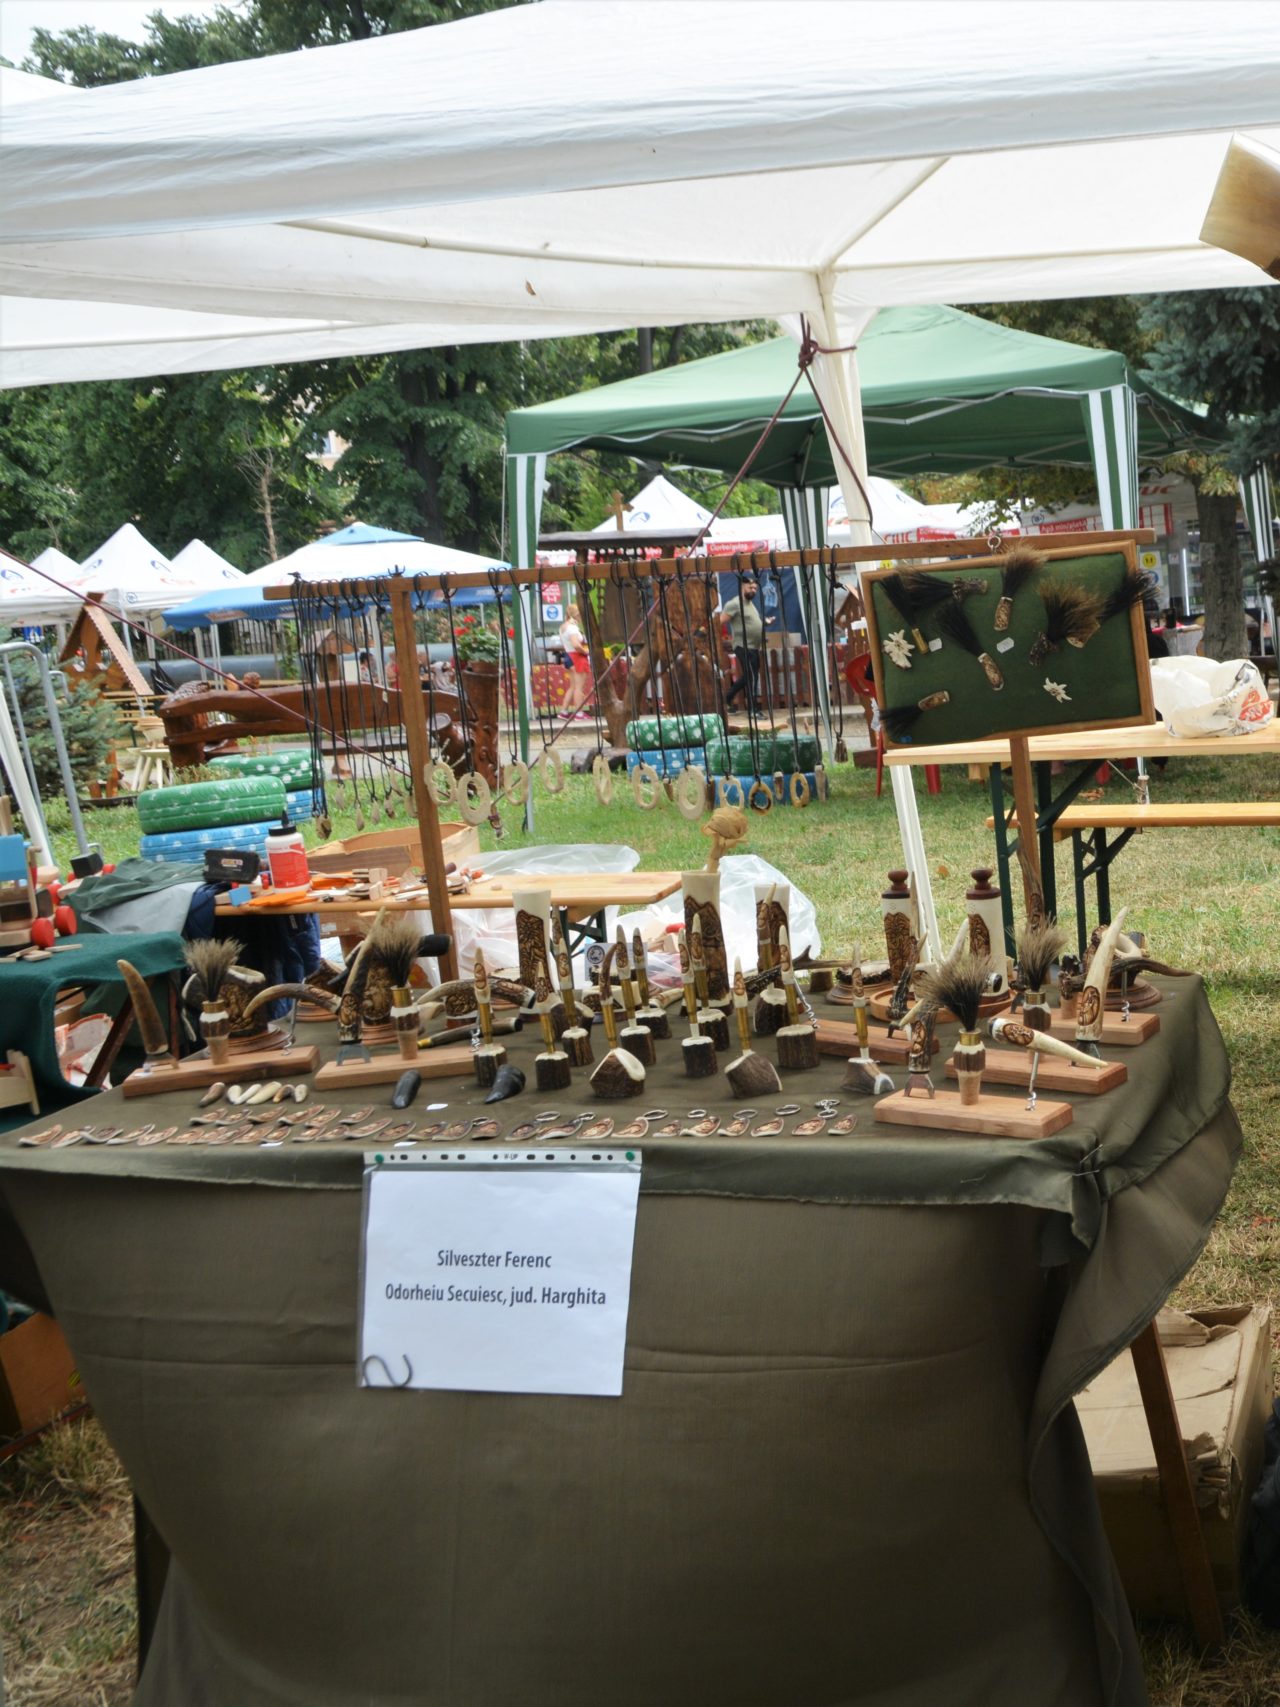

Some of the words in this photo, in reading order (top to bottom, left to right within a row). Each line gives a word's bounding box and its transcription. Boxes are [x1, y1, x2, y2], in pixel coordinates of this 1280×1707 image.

[437, 1249, 502, 1267] Silveszter
[504, 1251, 552, 1268] Ferenc
[385, 1283, 444, 1301] Odorheiu
[447, 1284, 507, 1306] Secuiesc,
[509, 1286, 537, 1308] jud.
[541, 1287, 606, 1309] Harghita
